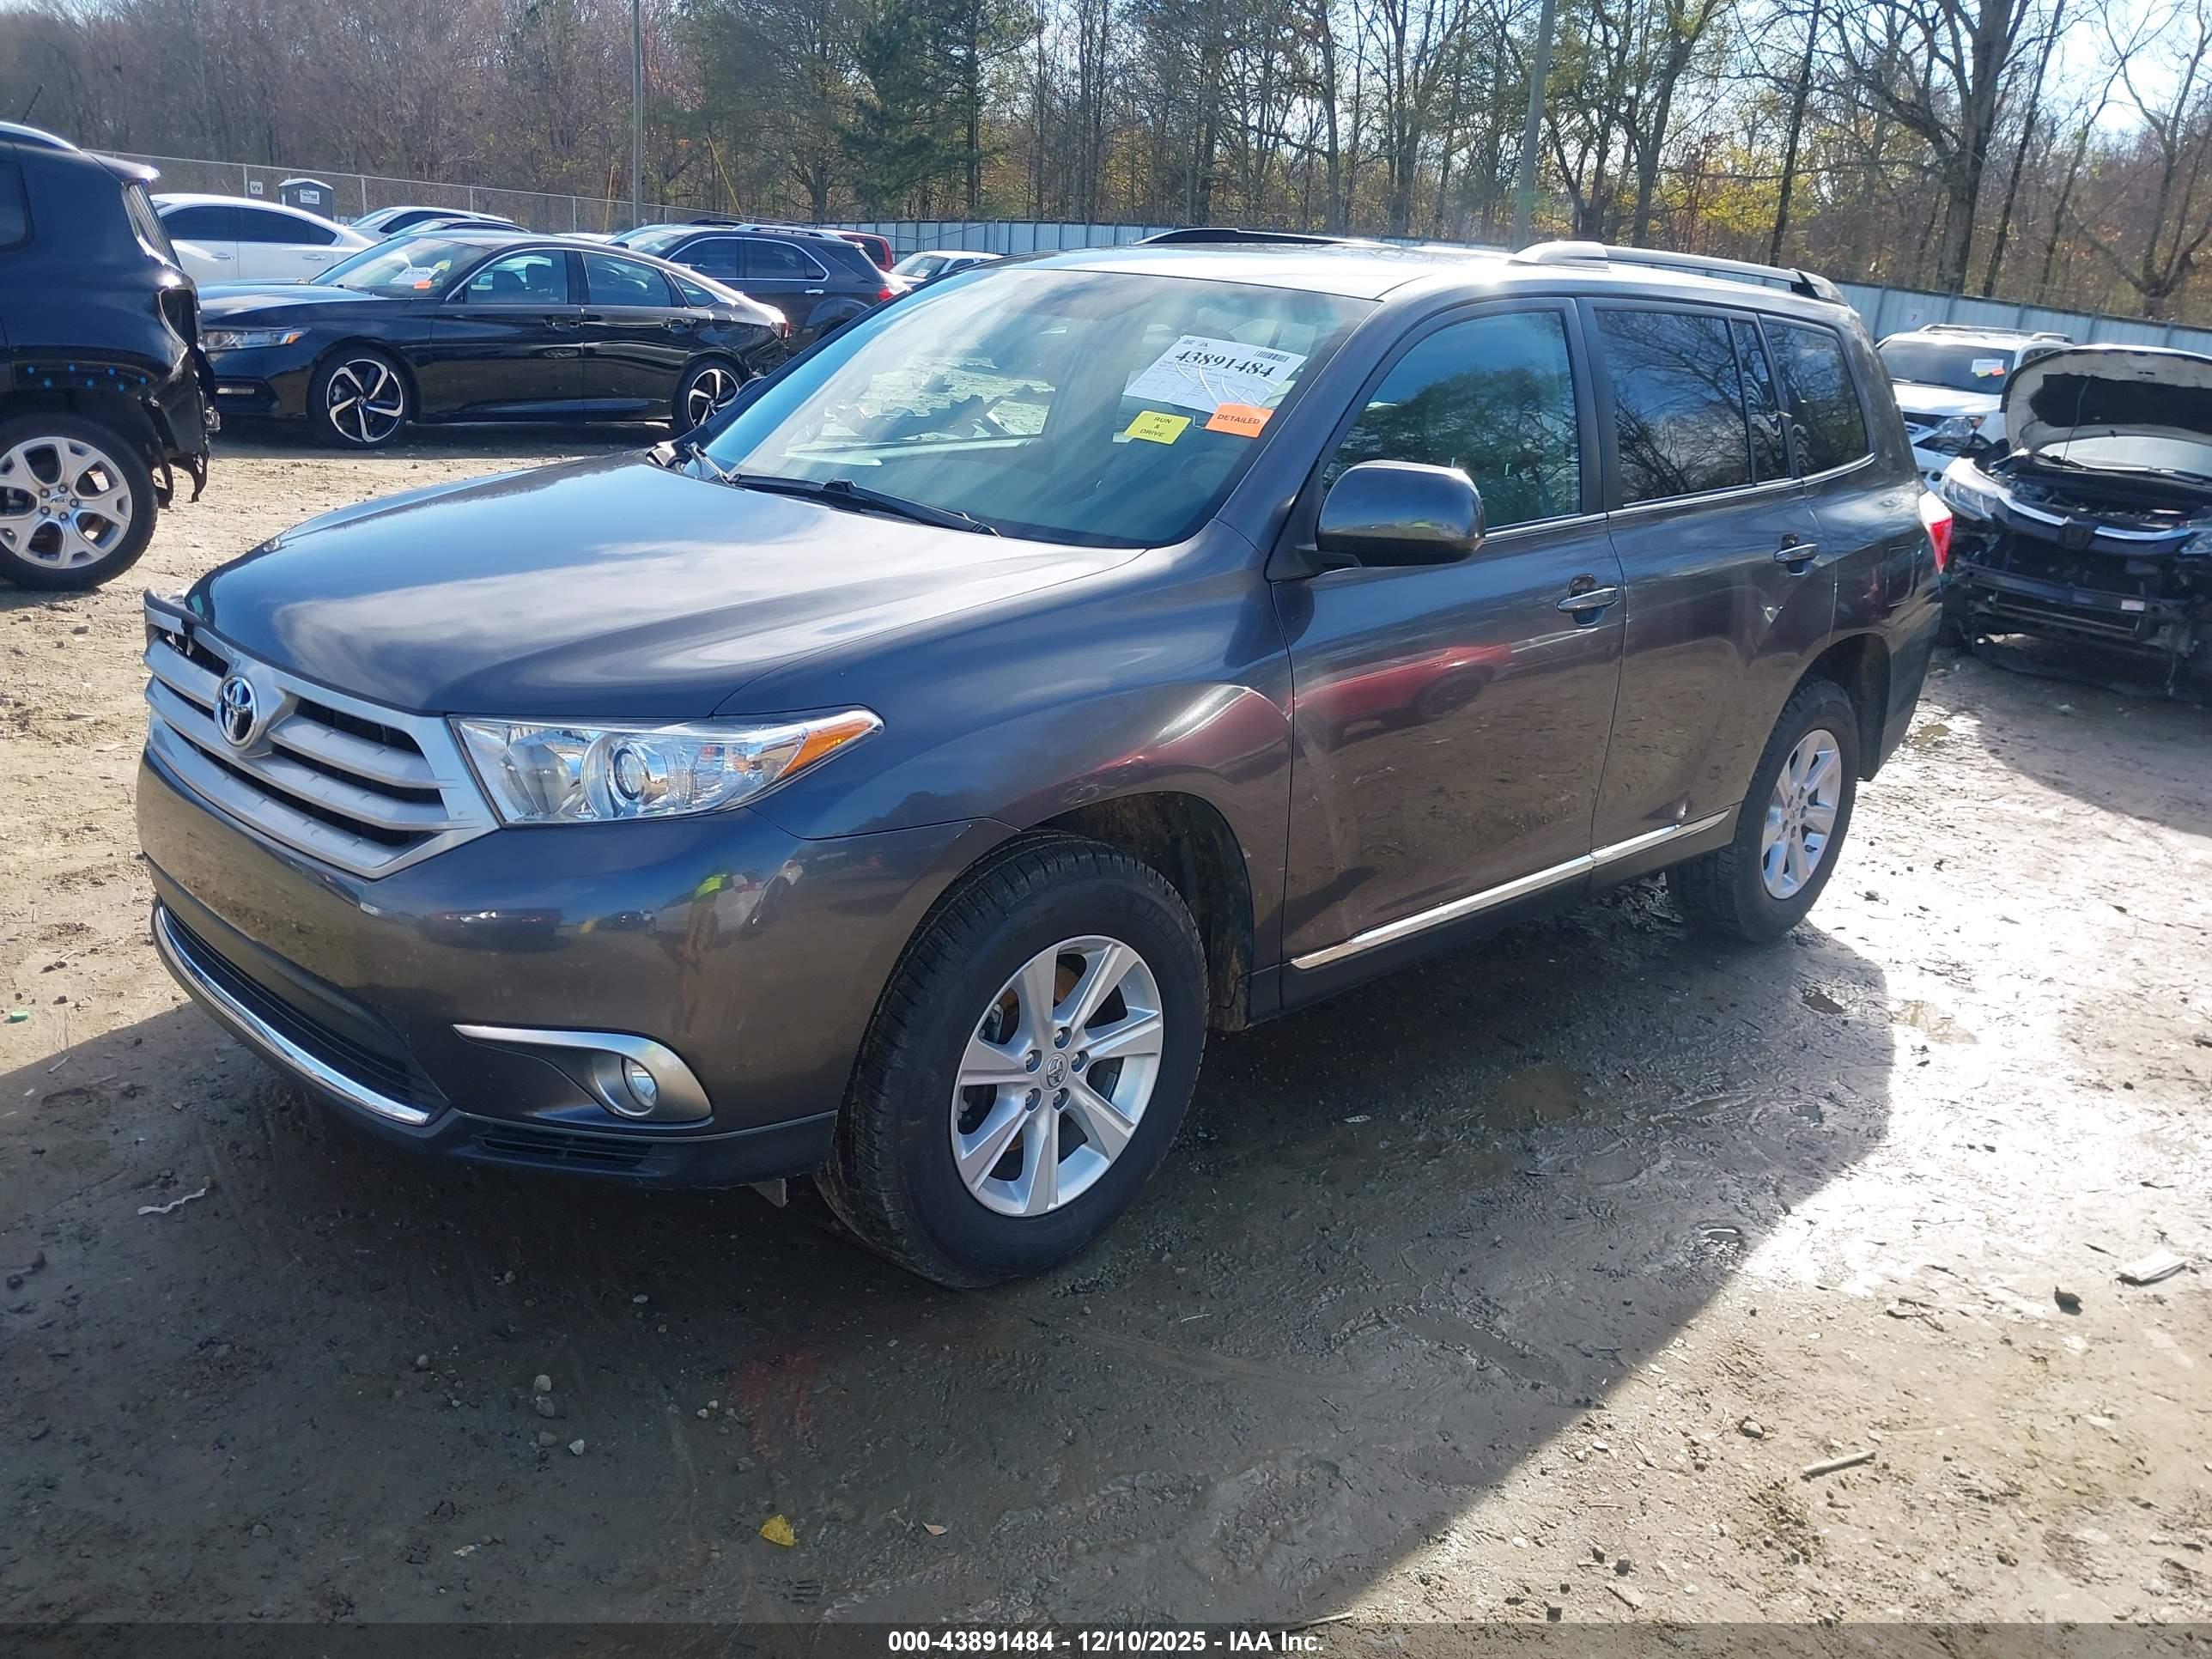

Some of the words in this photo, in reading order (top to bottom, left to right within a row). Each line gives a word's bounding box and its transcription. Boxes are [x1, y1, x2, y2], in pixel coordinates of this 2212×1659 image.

[1175, 350, 1276, 378] 43891484
[1217, 414, 1261, 424] DETAILED
[1139, 428, 1166, 438] DRIVE
